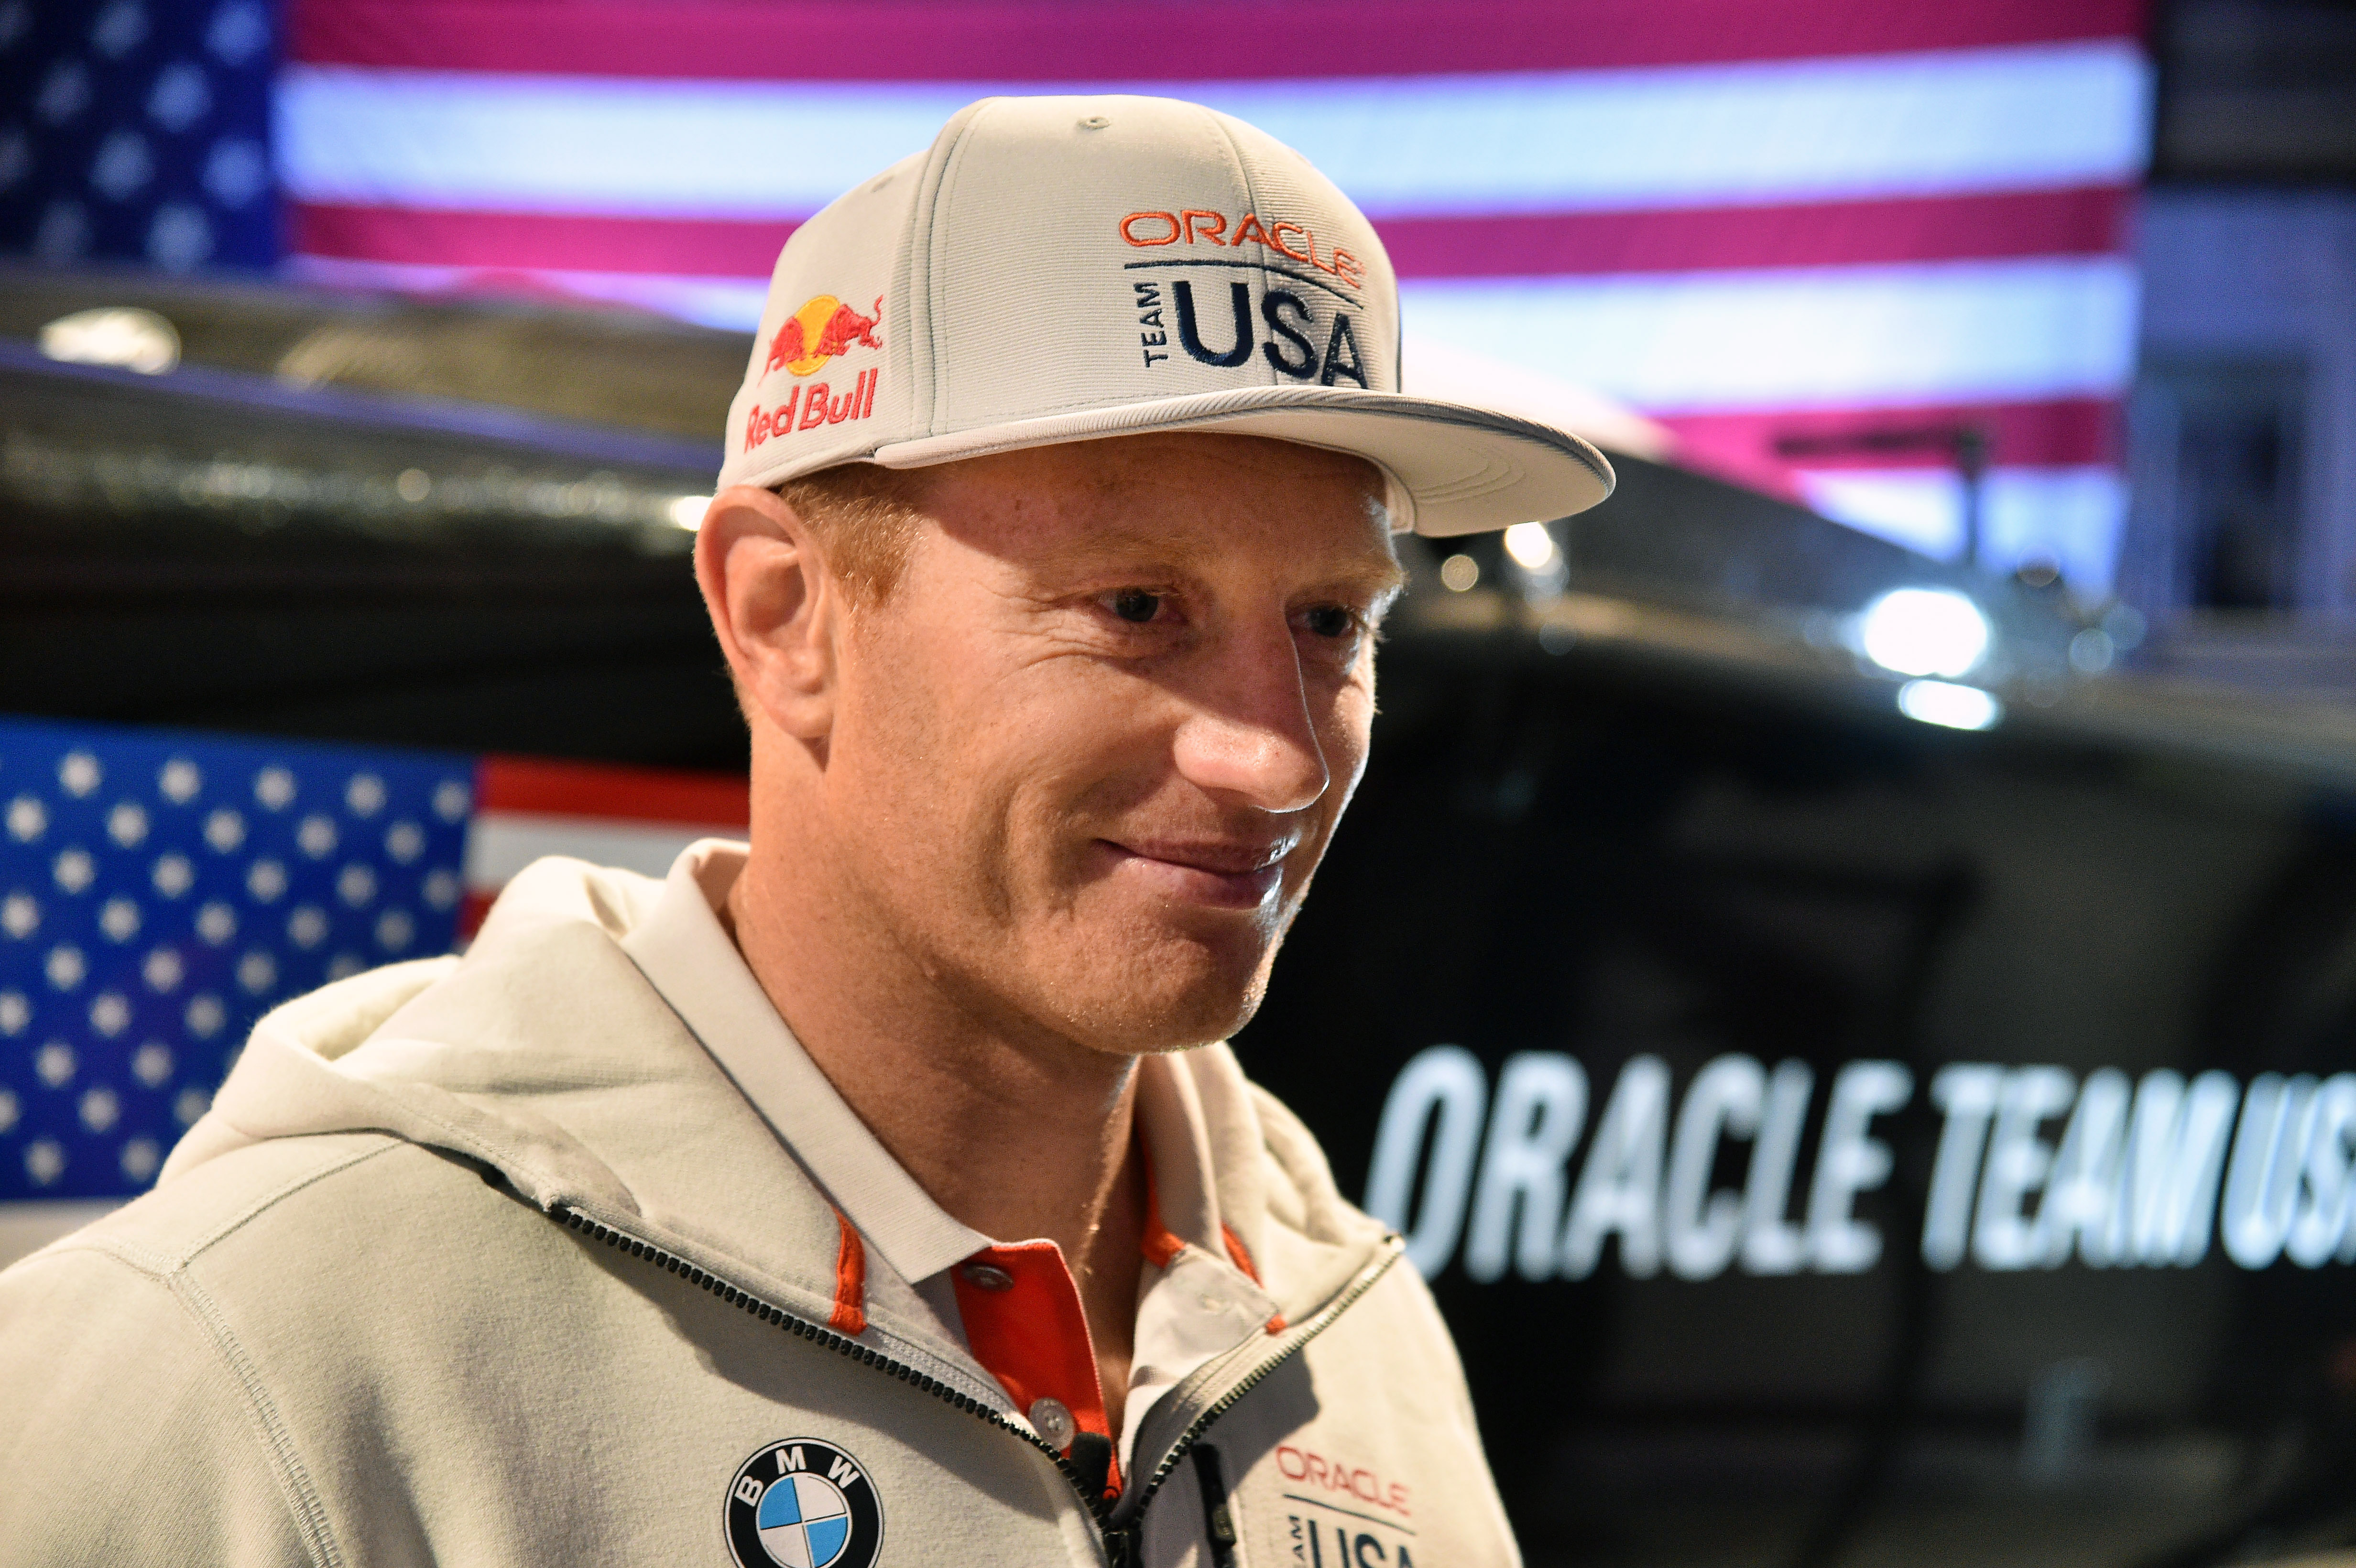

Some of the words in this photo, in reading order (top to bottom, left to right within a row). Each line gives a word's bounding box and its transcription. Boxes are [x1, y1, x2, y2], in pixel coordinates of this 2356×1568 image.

[1119, 209, 1367, 289] ORACLE
[1133, 281, 1168, 368] TEAM
[1172, 281, 1368, 390] USA
[743, 385, 800, 454] Red
[797, 367, 878, 431] Bull
[1363, 1045, 1915, 1282] ORACLE
[1920, 1062, 2242, 1272] TEAM
[2219, 1072, 2356, 1269] US
[734, 1445, 860, 1507] BMW
[1275, 1445, 1411, 1516] ORACLE
